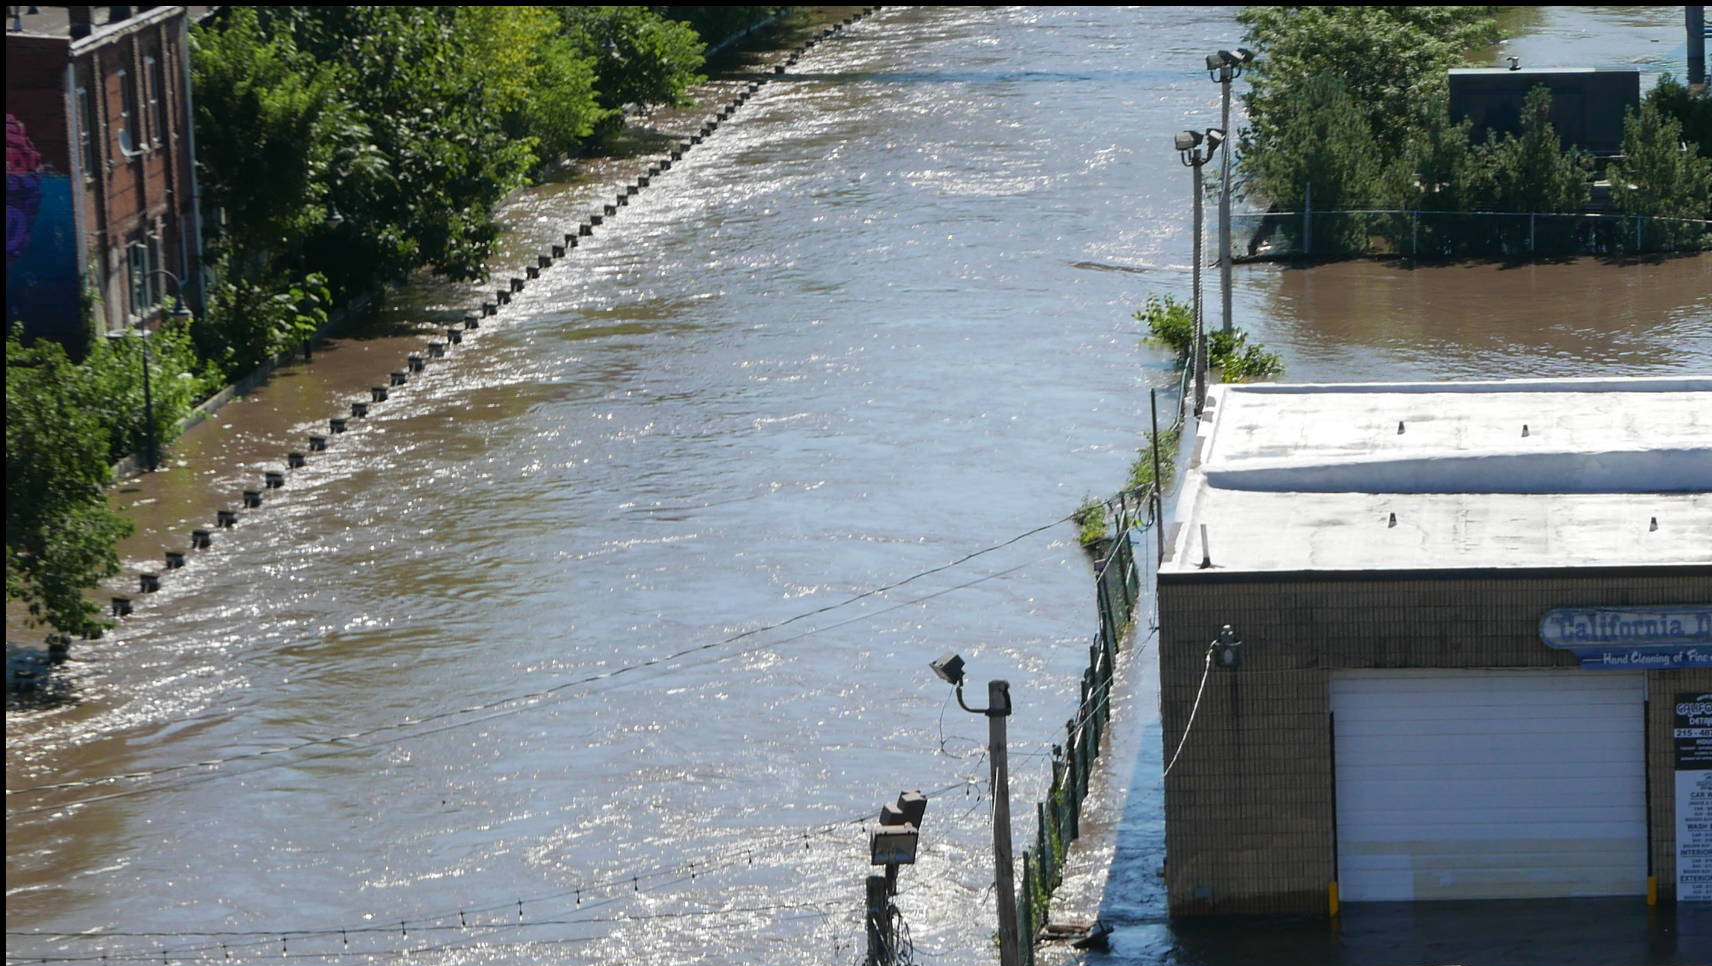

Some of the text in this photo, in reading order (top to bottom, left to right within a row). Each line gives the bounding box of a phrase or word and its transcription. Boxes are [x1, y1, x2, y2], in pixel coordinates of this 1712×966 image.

[1603, 652, 1628, 664] Hand
[1631, 651, 1670, 665] Cleaning
[1673, 651, 1683, 663] of
[1687, 648, 1707, 662] Fine
